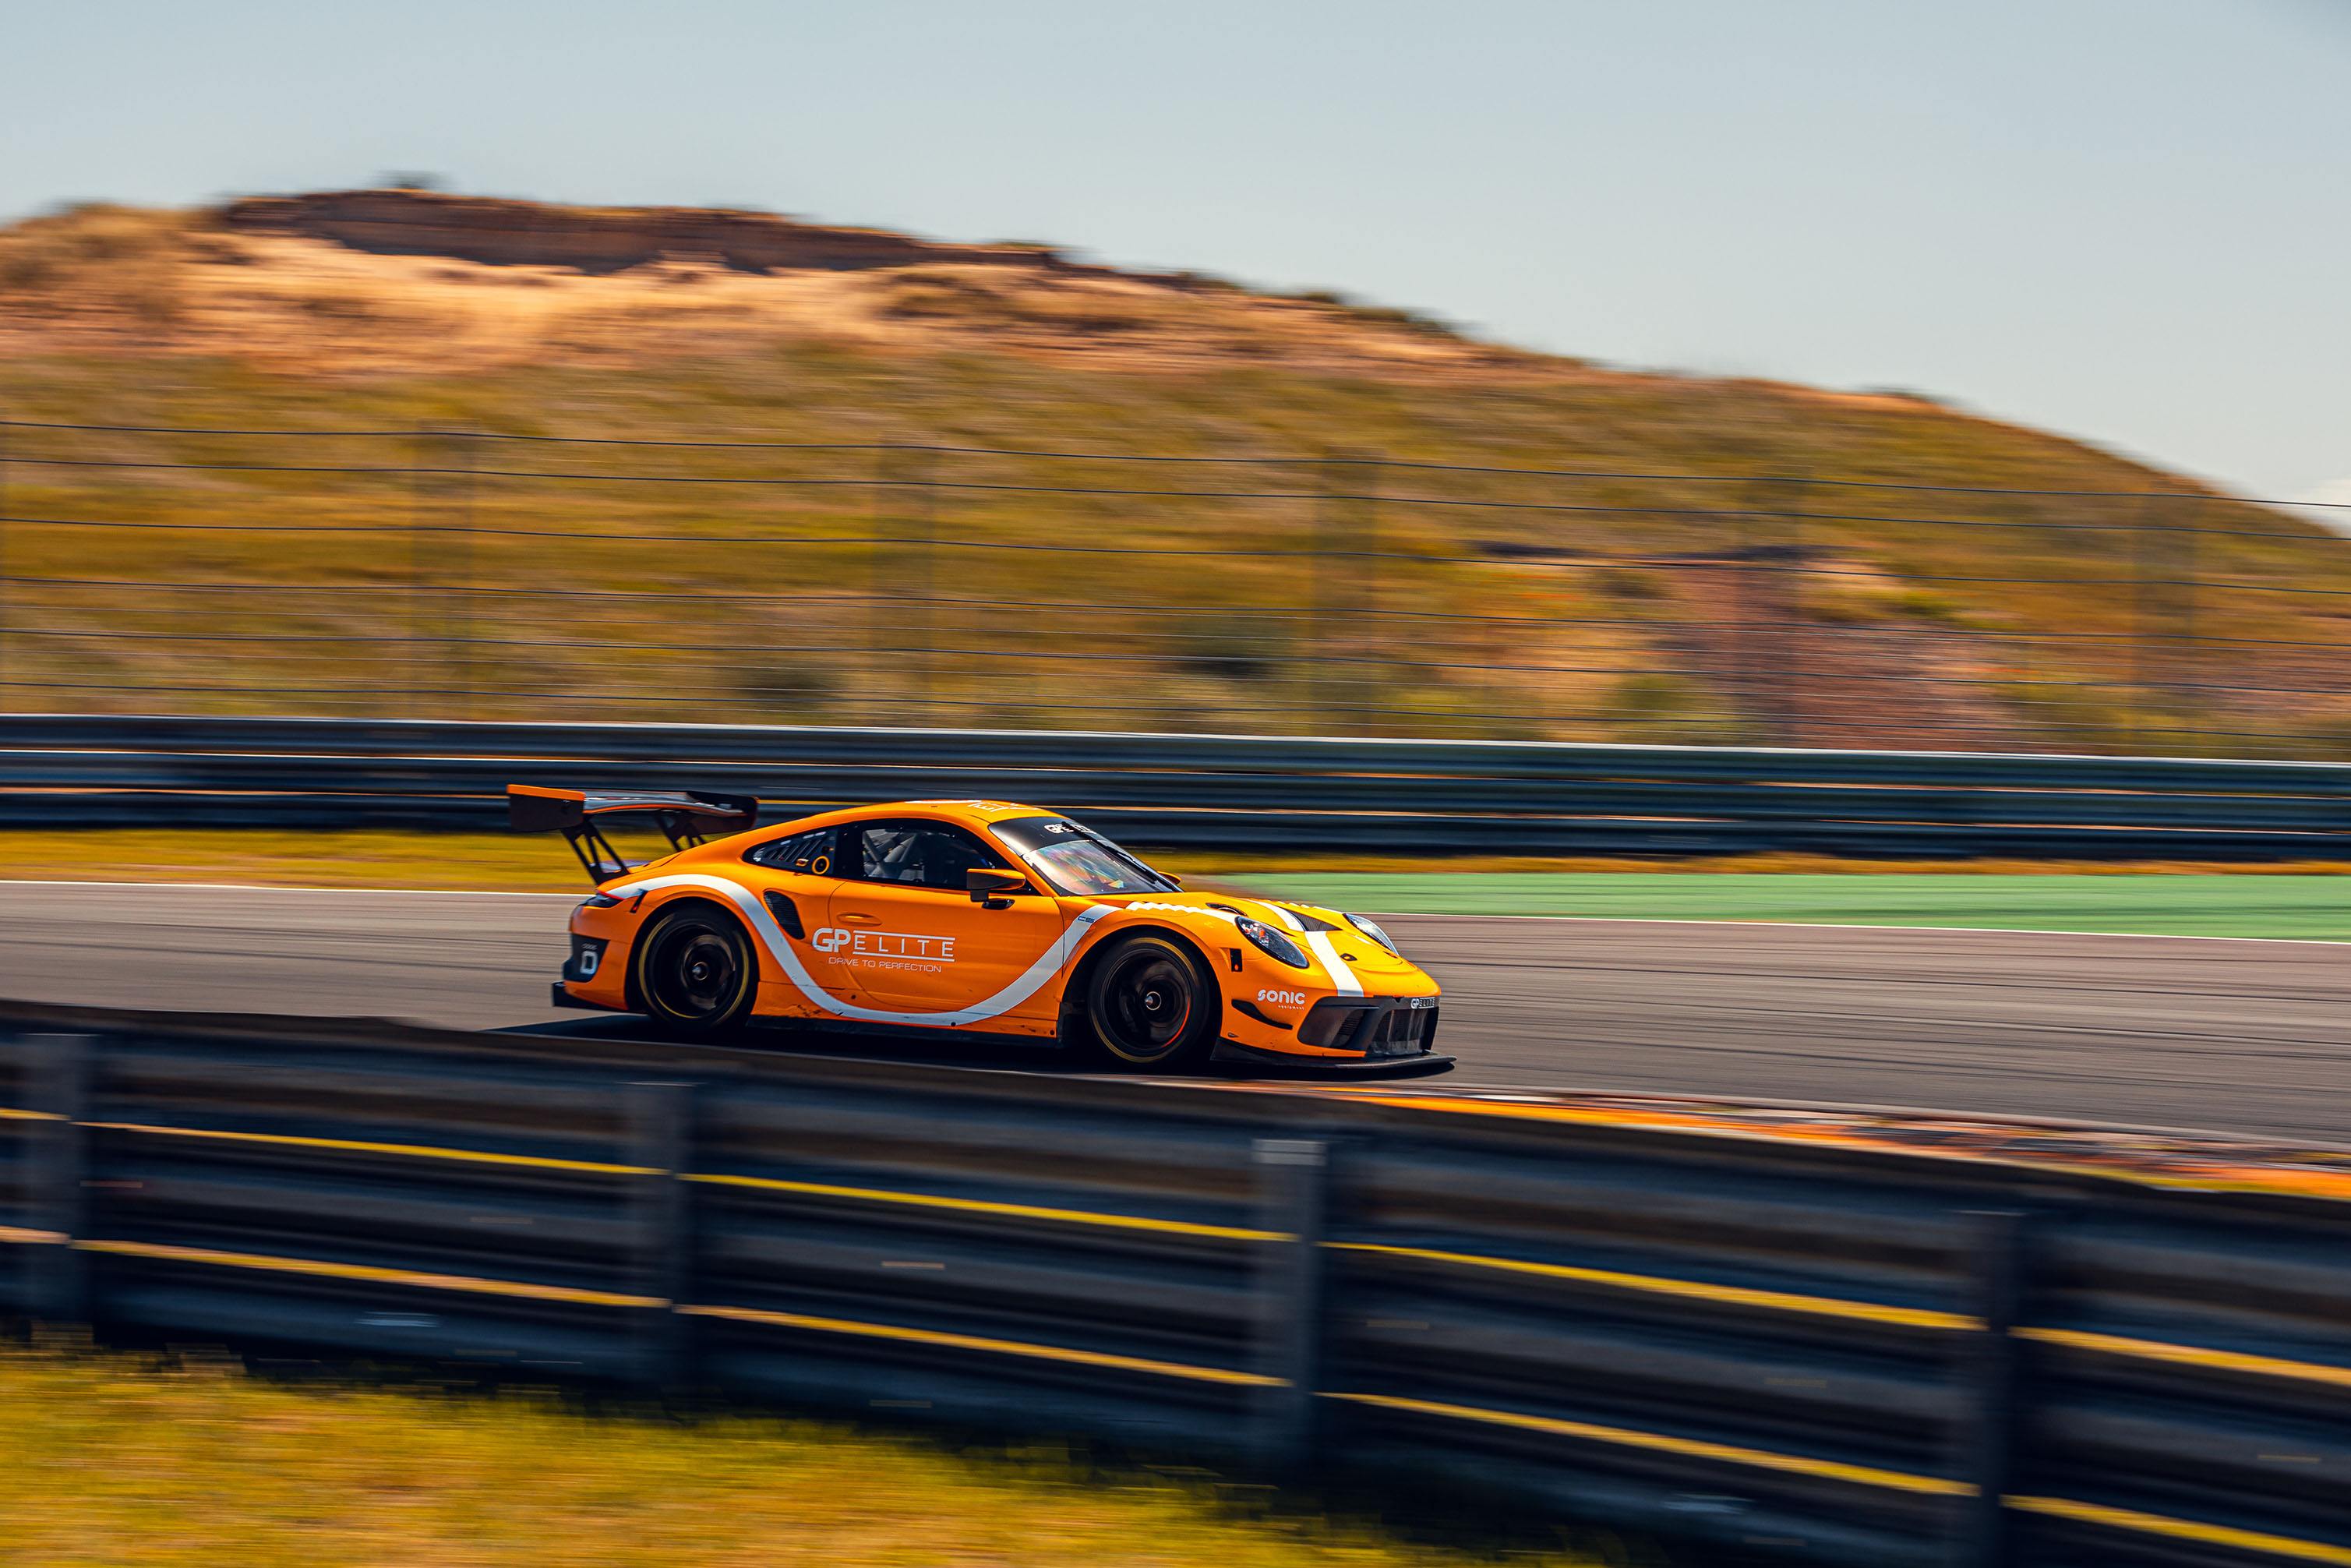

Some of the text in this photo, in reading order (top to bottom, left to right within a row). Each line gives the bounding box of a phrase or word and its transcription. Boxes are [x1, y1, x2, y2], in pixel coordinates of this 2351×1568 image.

[828, 957, 941, 973] DRIVE TO PERFECTION
